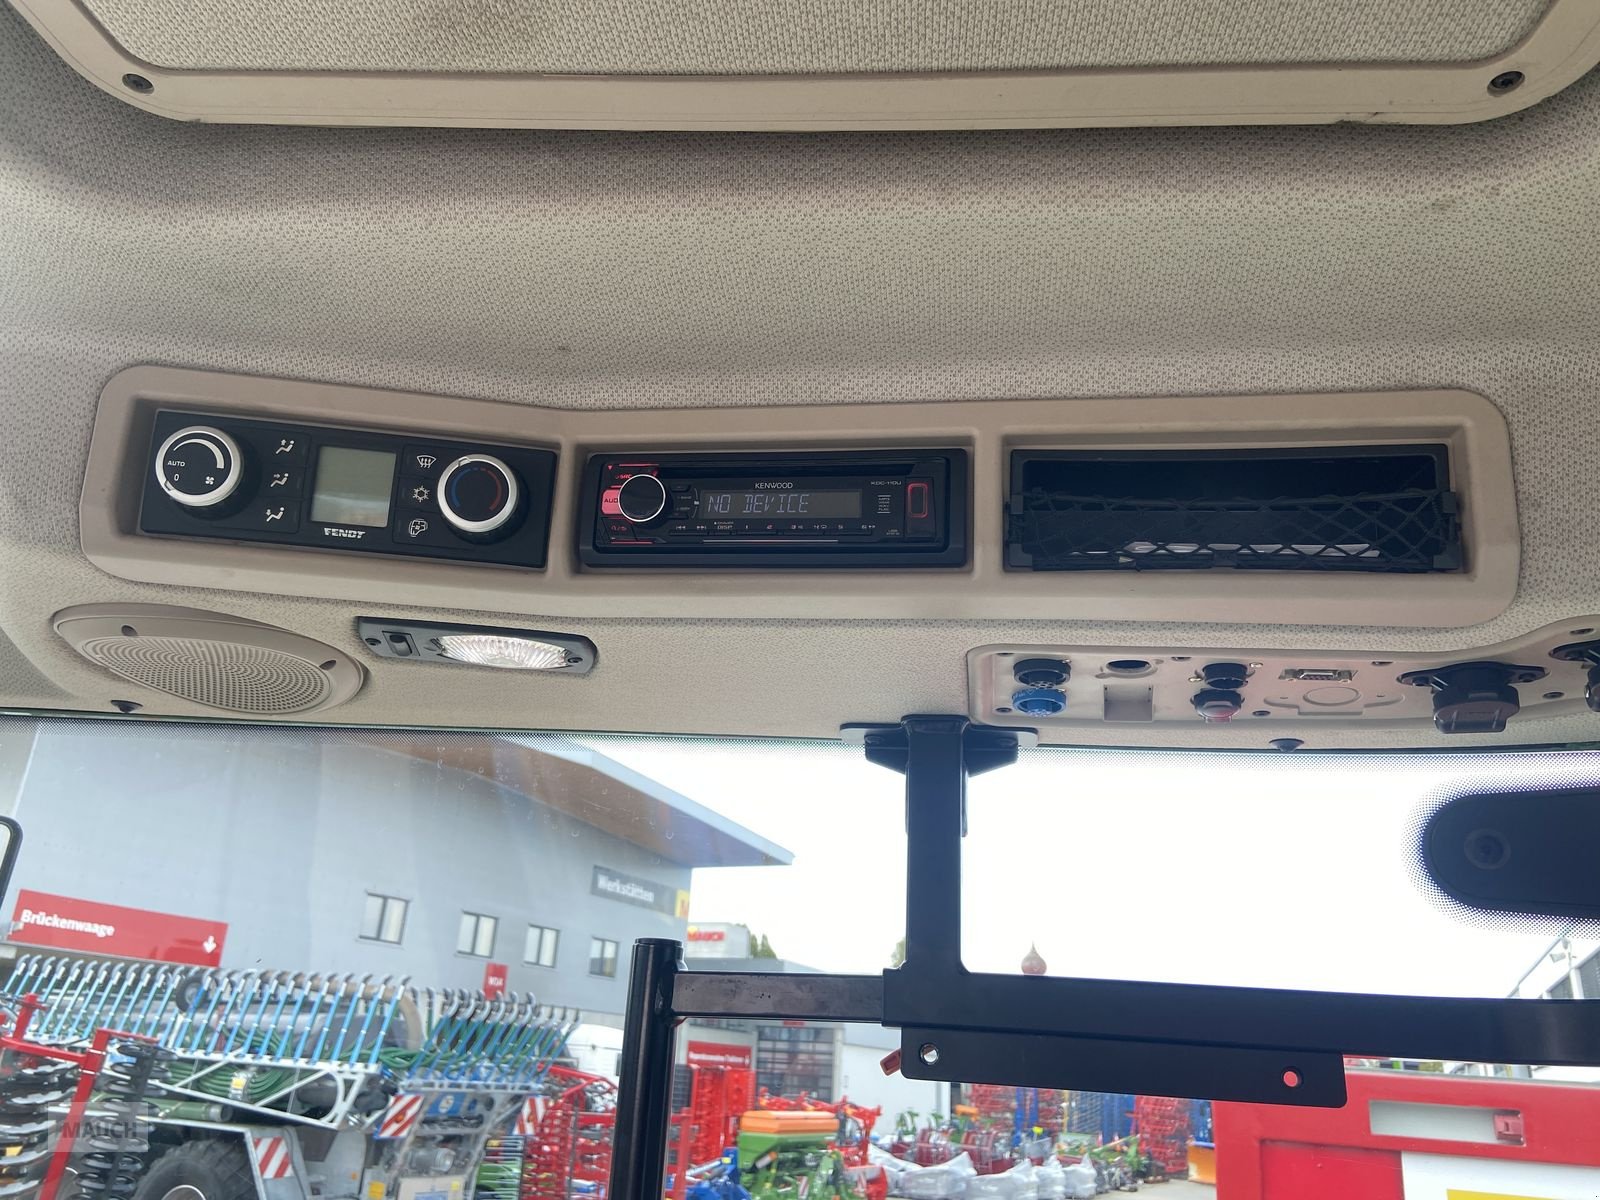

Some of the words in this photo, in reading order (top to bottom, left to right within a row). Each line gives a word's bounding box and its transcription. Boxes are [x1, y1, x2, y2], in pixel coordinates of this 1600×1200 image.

[755, 482, 794, 490] KENWOOD
[707, 494, 731, 513] NO
[742, 494, 810, 513] DEVICE
[323, 527, 366, 539] FENDT
[597, 873, 655, 903] Werkstätten
[20, 909, 115, 938] Brückenwaage
